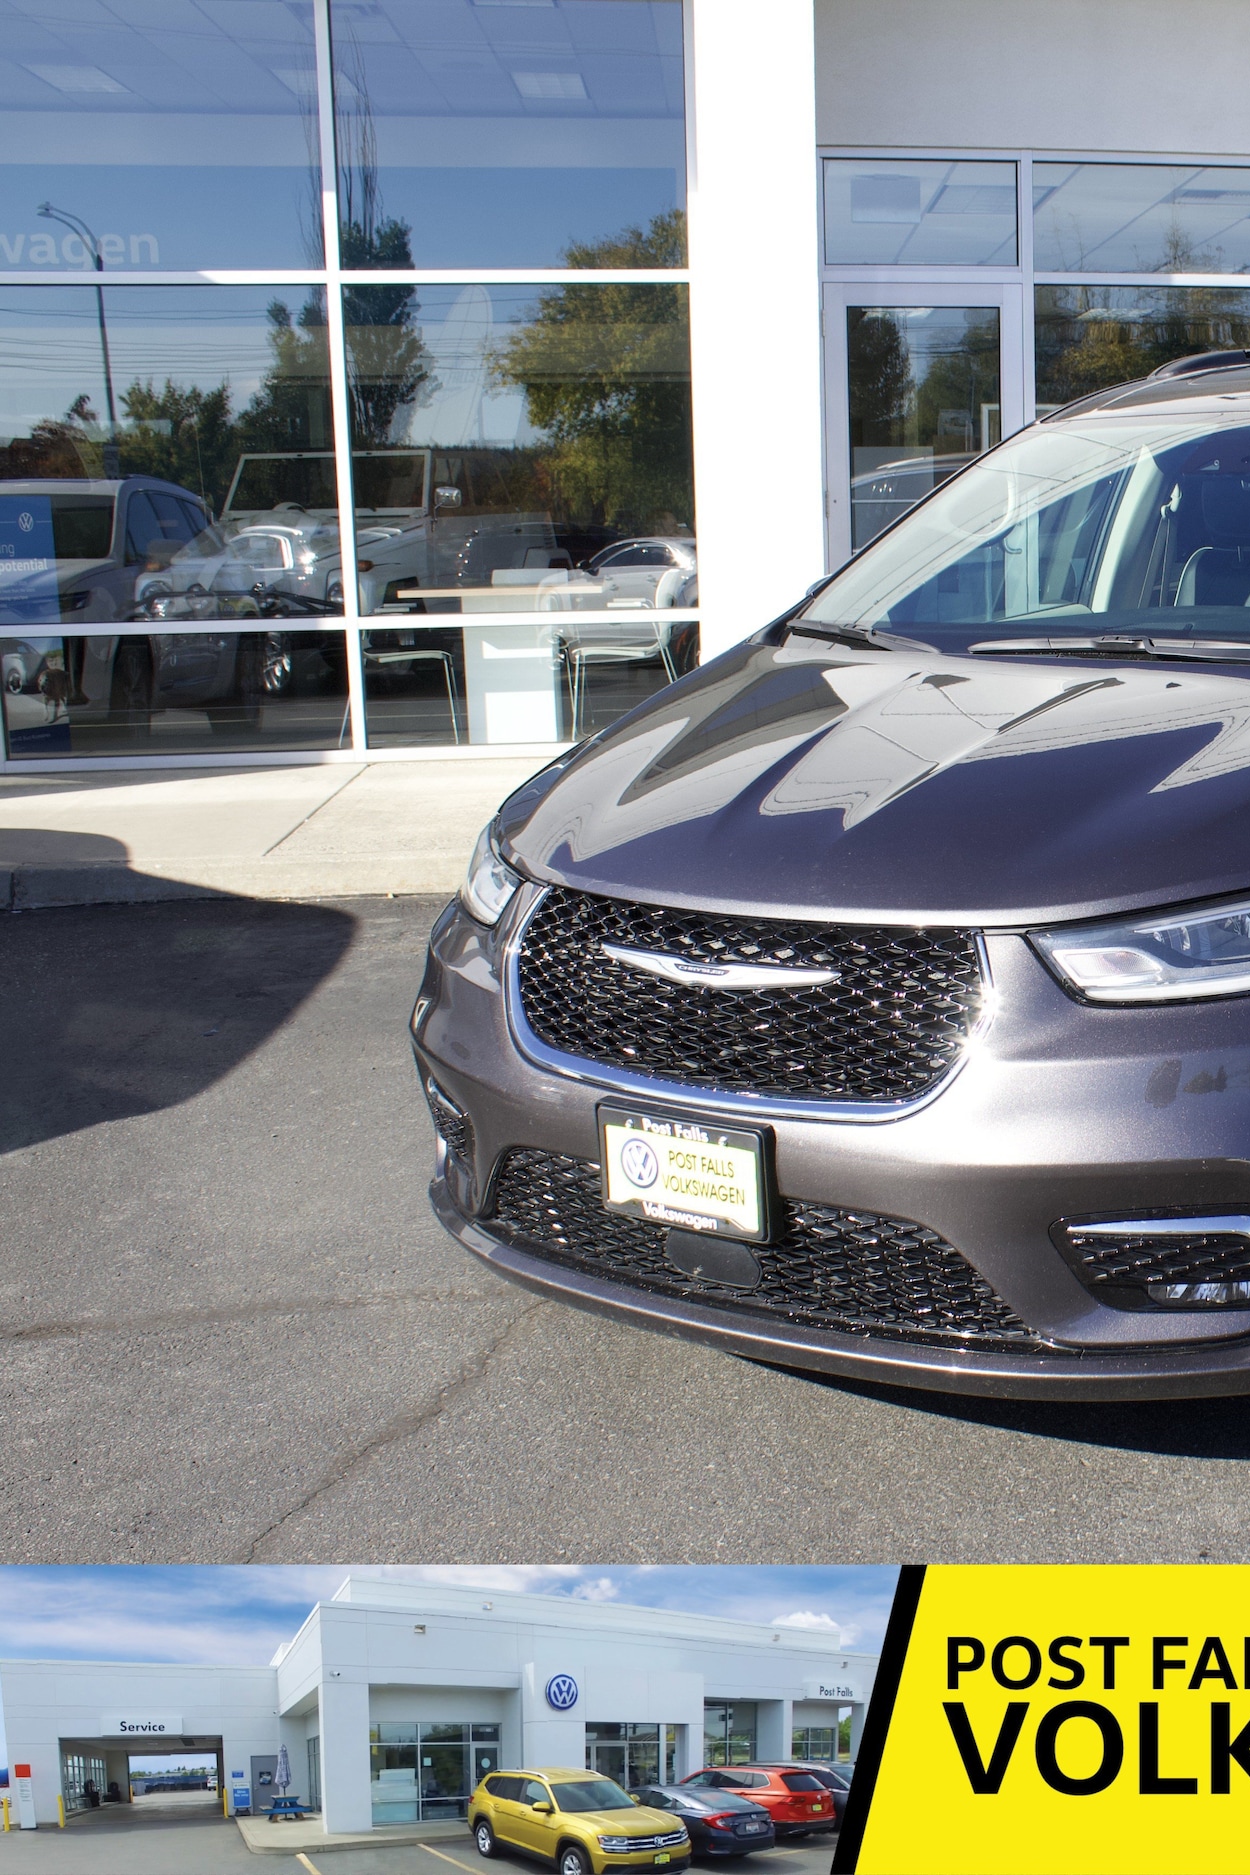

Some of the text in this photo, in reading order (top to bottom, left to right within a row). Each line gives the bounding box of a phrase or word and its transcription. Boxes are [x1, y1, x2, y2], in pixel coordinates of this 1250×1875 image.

[0, 558, 48, 575] potential
[641, 1117, 709, 1143] Post Falls
[668, 1150, 735, 1178] POST FALLS
[661, 1174, 746, 1206] VOLKSWAGEN
[642, 1200, 718, 1230] Volkswagen
